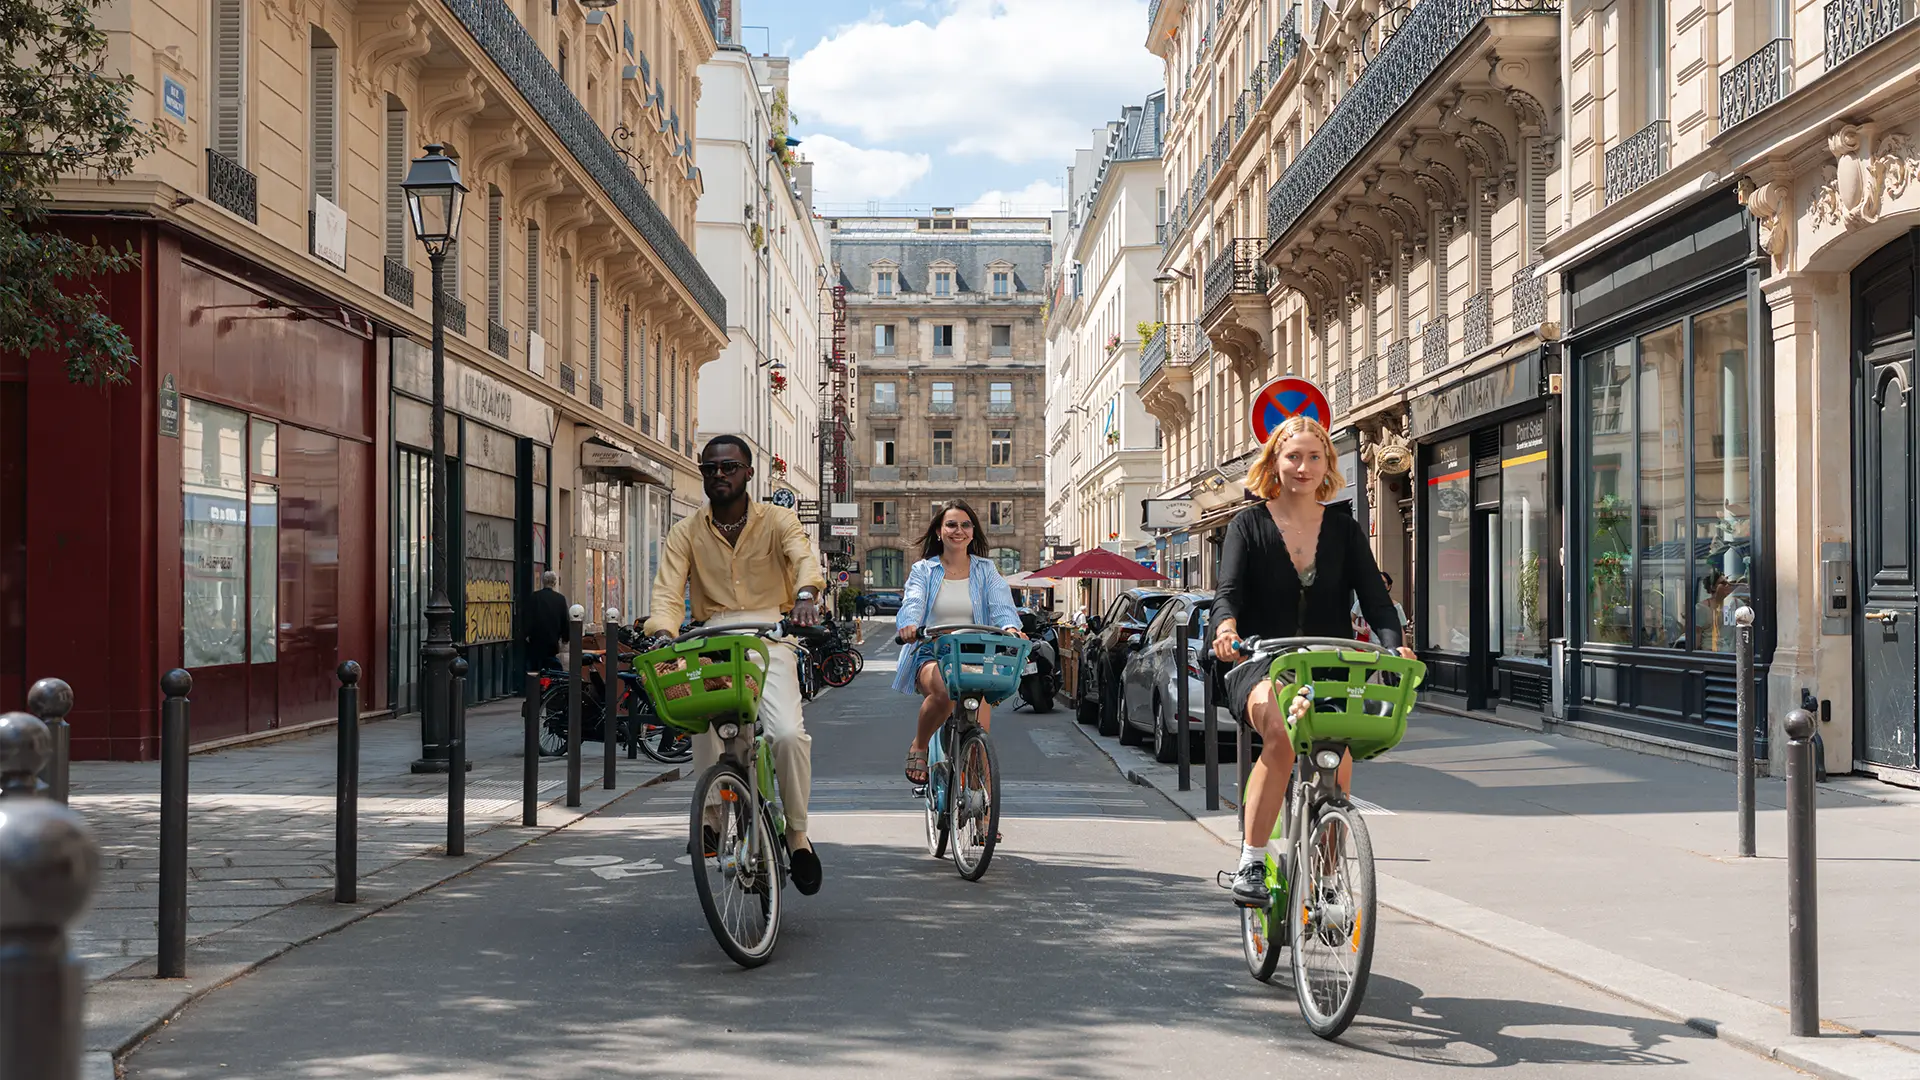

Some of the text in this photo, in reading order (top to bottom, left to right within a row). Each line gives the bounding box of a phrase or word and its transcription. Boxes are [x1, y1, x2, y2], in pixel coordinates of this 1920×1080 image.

[465, 373, 512, 422] ULTRAMOD
[1165, 502, 1193, 510] L'ENTENTE
[1078, 569, 1123, 577] BOLLINGER
